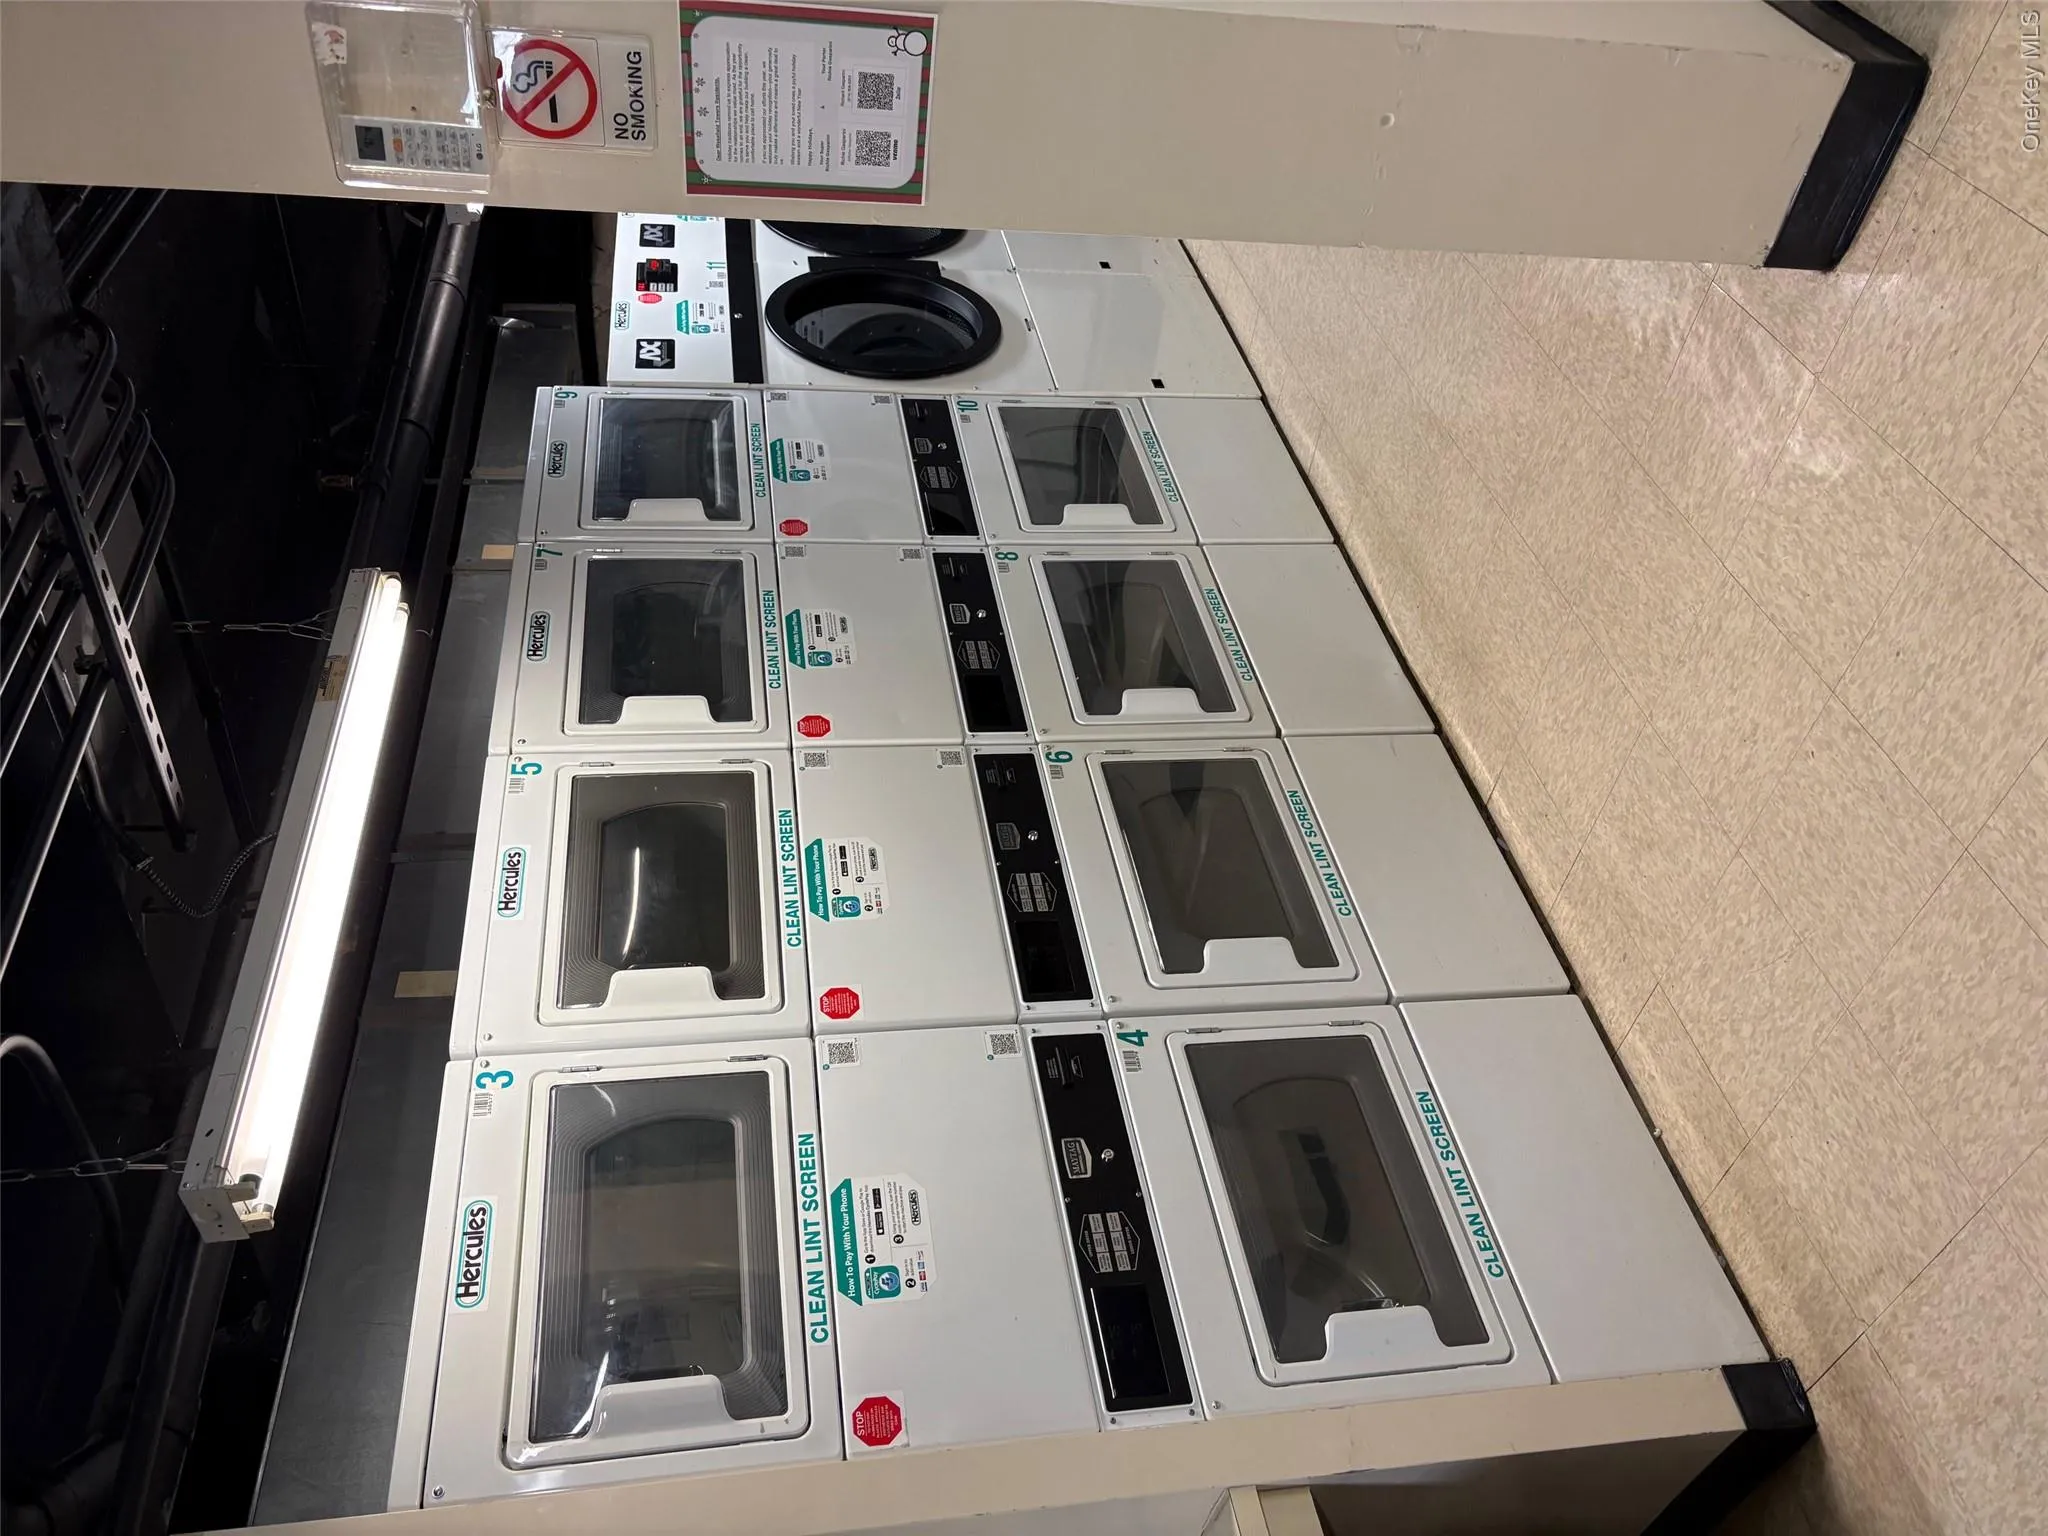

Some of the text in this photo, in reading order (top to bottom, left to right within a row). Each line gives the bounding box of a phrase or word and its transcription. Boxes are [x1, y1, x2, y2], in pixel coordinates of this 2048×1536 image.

[626, 51, 647, 142] SMOKING
[613, 113, 629, 140] NO
[475, 143, 482, 153] LG
[706, 261, 726, 270] 11
[614, 302, 628, 328] Hercules
[554, 391, 578, 399] 9
[956, 400, 979, 413] 10
[548, 442, 564, 475] Hercules
[750, 423, 767, 498] CLEAN LINT SCREEN
[1142, 431, 1179, 503] CLEAN LINT SCREEN
[537, 548, 563, 558] 7
[994, 551, 1019, 561] 8
[527, 614, 547, 657] Hercules
[762, 589, 782, 689] CLEAN LINT SCREEN
[1204, 588, 1254, 681] CLEAN LINT SCREEN
[511, 762, 543, 776] 5
[1044, 750, 1073, 764] 6
[1286, 790, 1352, 916] CLEAN LINT SCREEN
[498, 852, 521, 911] Hercules
[778, 809, 802, 948] CLEAN LINT SCREEN
[815, 885, 823, 896] Pay
[822, 996, 831, 1013] STOP
[1116, 1029, 1149, 1047] 4
[475, 1070, 514, 1089] 3
[1067, 1142, 1081, 1174] MAYTAG
[1415, 1091, 1505, 1278] CLEAN LINT SCREEN
[909, 1191, 920, 1223] Hercules
[456, 1207, 487, 1299] Hercules
[797, 1133, 830, 1344] CLEAN LINT SCREEN
[839, 1188, 856, 1297] How To Pay With Your Phone
[856, 1411, 865, 1436] STOP
